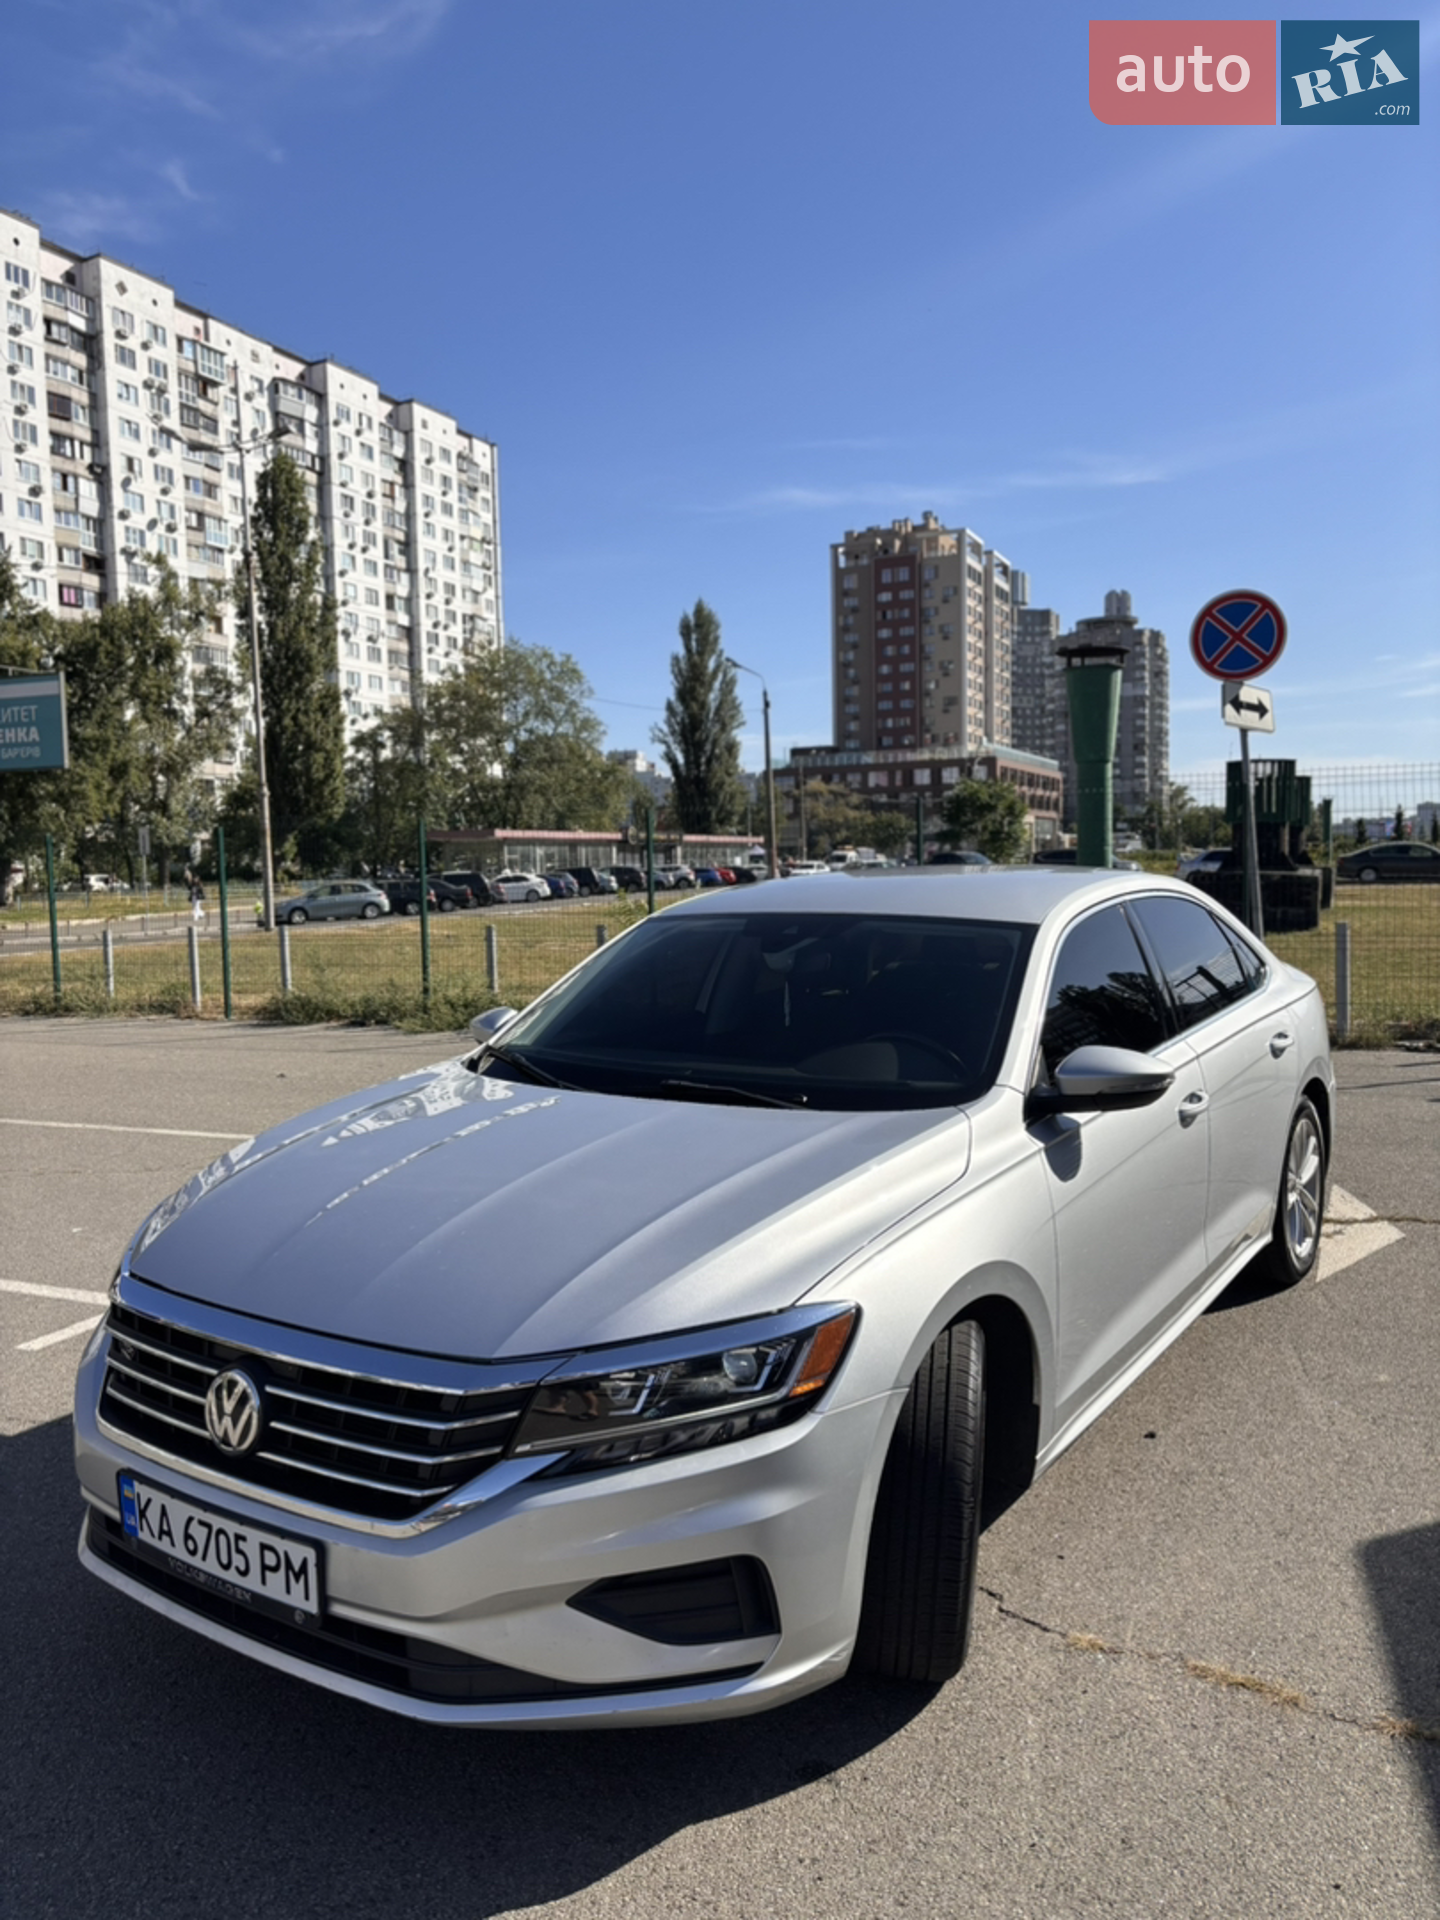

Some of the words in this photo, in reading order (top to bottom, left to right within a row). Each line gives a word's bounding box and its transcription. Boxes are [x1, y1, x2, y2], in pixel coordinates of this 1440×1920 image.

[0, 704, 38, 724] ИТЕТ
[137, 1491, 176, 1548] KA
[184, 1515, 250, 1578] 6705
[259, 1541, 310, 1601] PM
